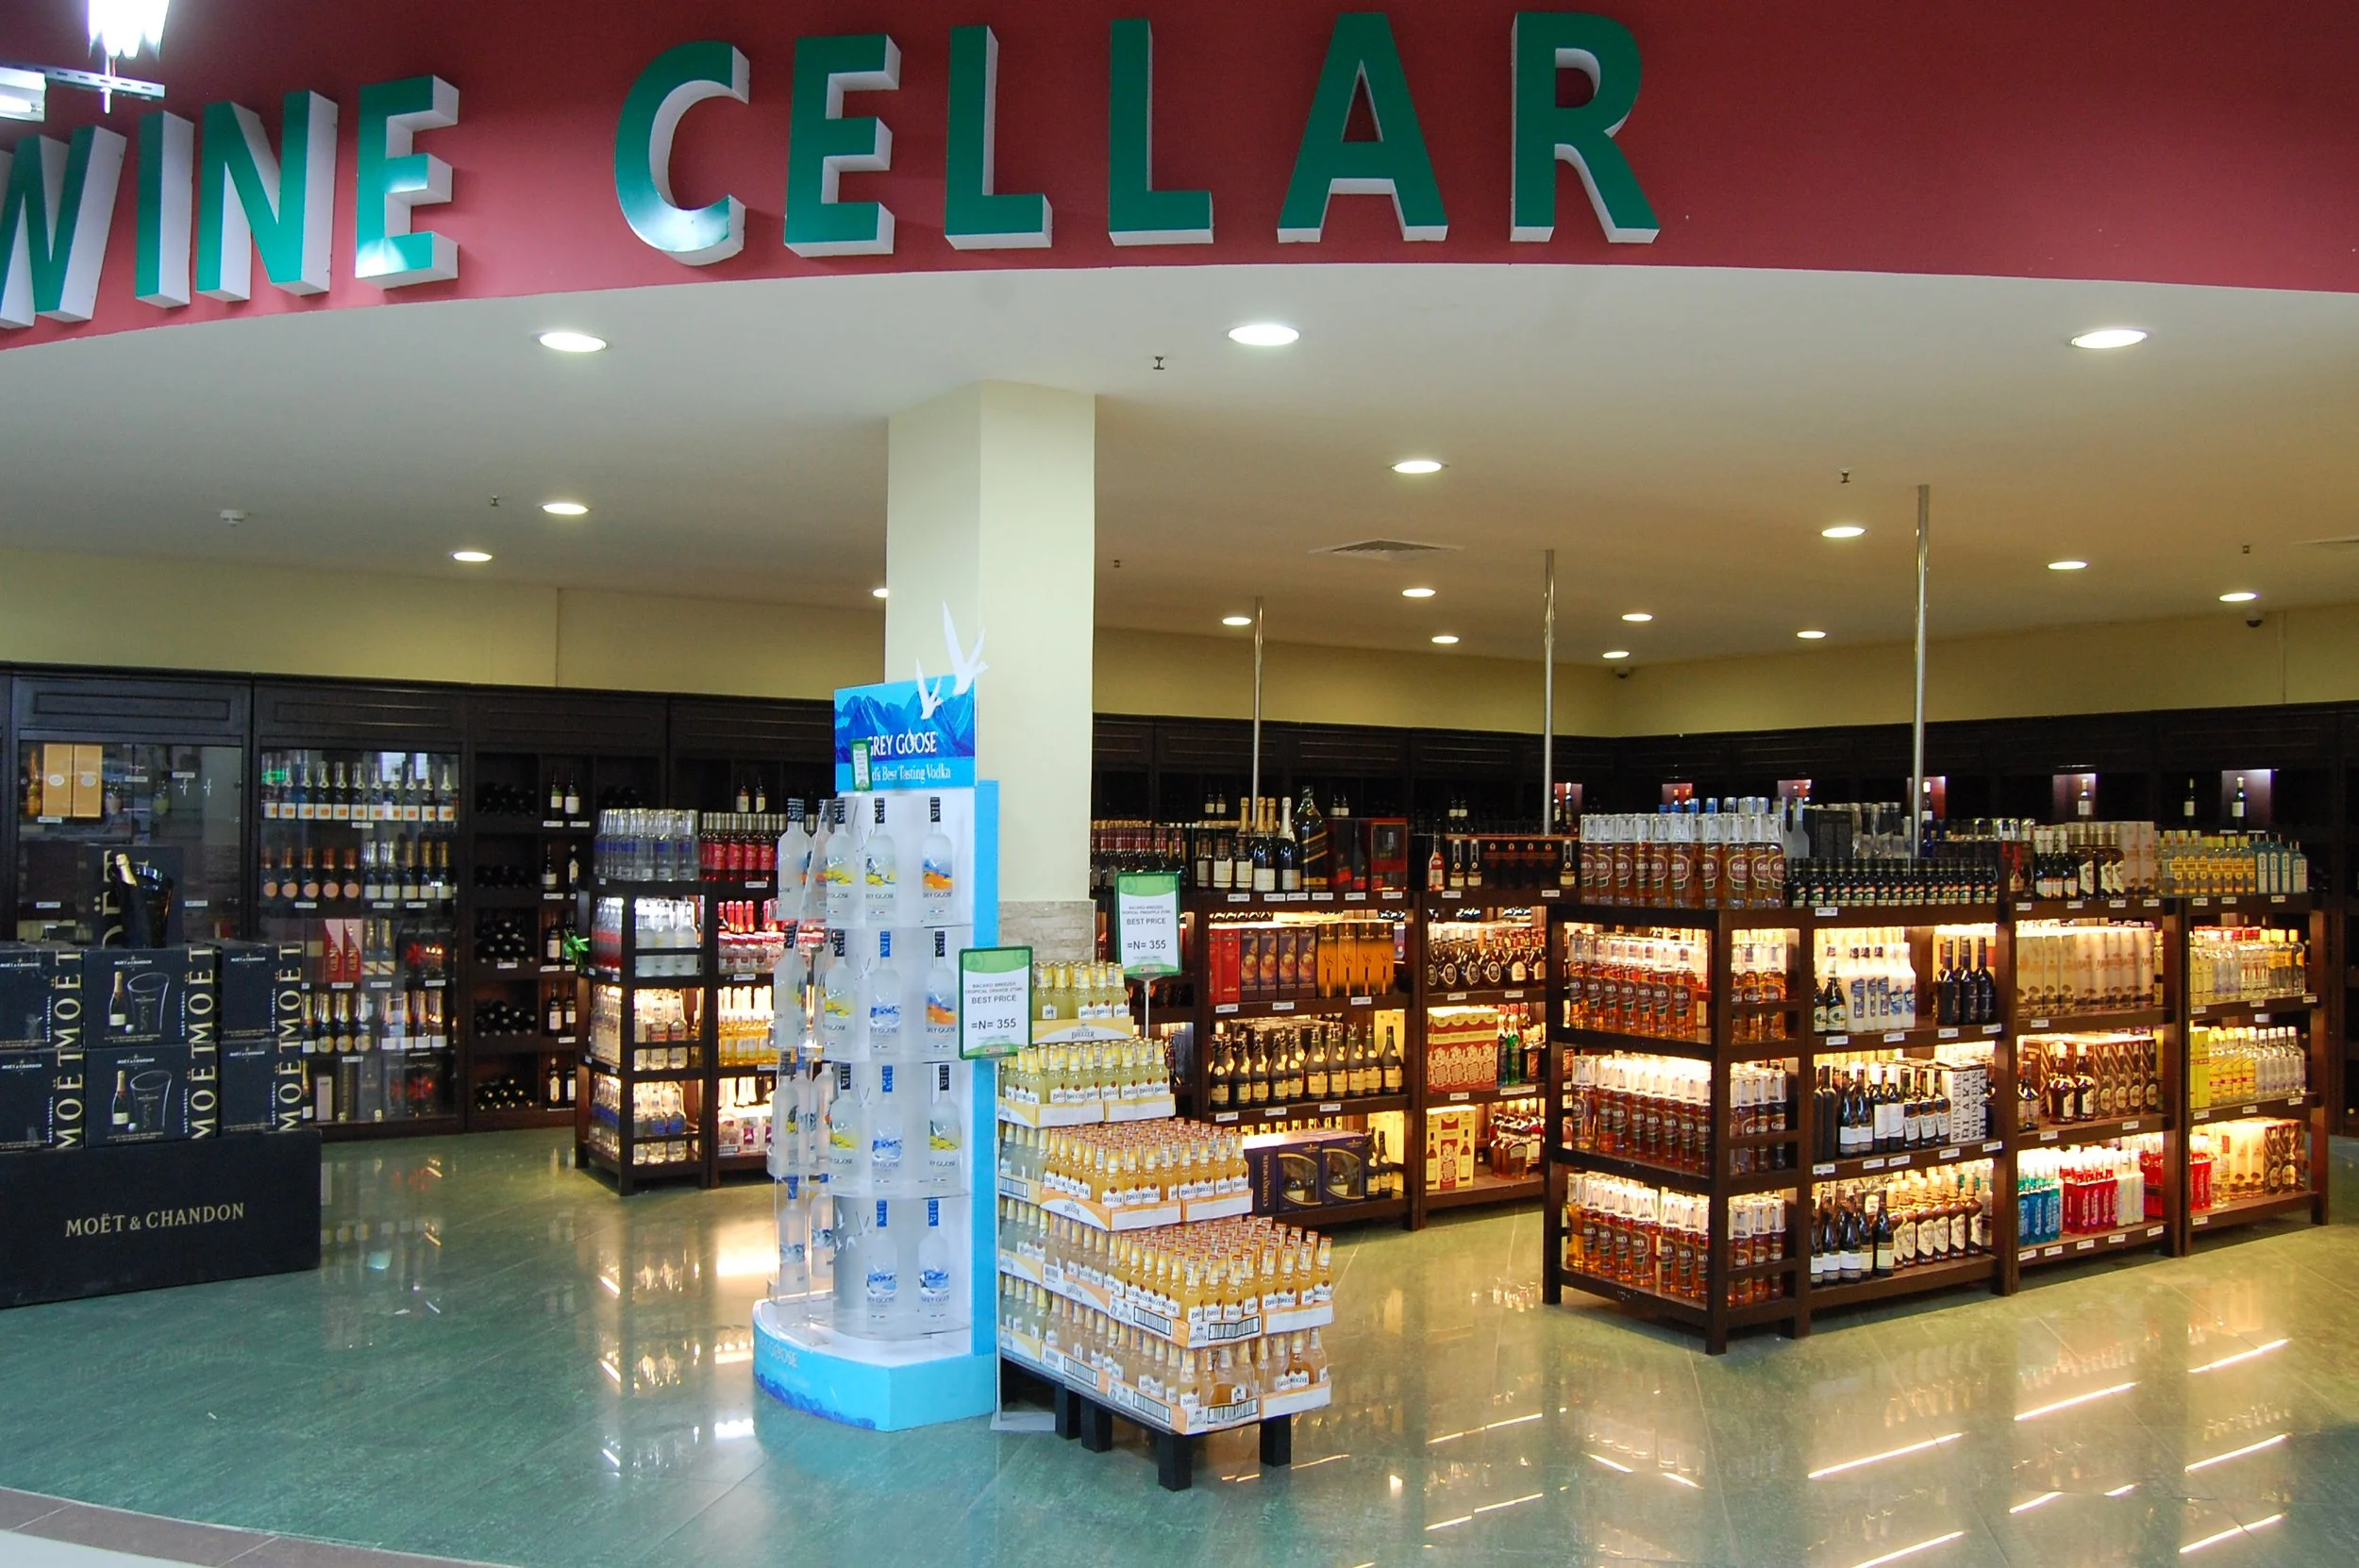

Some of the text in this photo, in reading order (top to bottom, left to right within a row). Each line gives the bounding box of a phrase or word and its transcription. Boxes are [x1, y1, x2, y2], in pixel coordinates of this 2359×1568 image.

[0, 11, 1661, 330] WINE CELLAR
[867, 731, 937, 757] GREY GOOSE
[882, 768, 897, 781] Best
[898, 763, 926, 785] Tasting
[926, 762, 951, 779] Vodka
[275, 944, 303, 1037] MOËT
[1127, 940, 1166, 950] =N= 355
[51, 950, 83, 1048] MOËT
[184, 946, 215, 1043] MOËT
[971, 1018, 1016, 1030] =N= 355
[994, 994, 1017, 1003] PRICE
[52, 1050, 84, 1148] MOËT
[186, 1043, 217, 1140] MOËT
[275, 1039, 303, 1130] MOËT
[65, 1202, 245, 1238] MOËT & CHANDON
